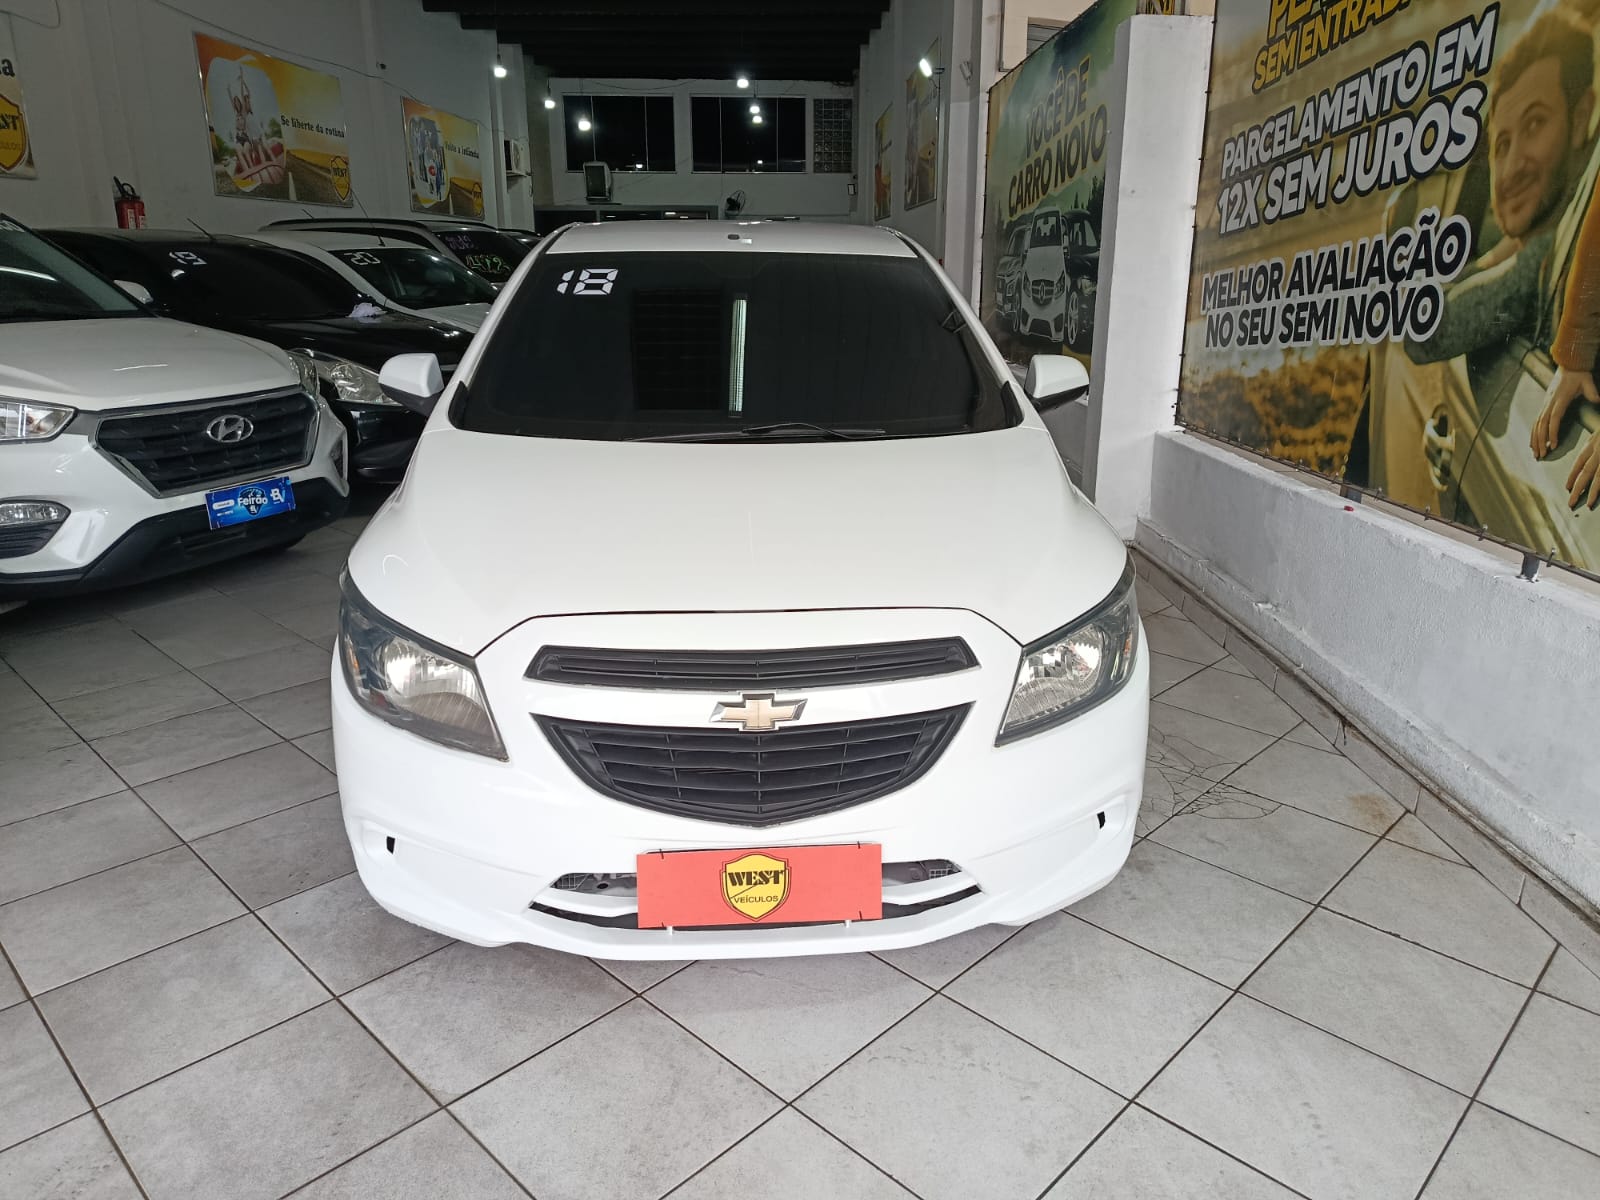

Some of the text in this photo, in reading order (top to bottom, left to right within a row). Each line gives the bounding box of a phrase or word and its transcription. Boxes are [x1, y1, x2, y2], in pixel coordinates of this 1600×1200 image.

[1253, 30, 1297, 91] SEM
[1026, 57, 1090, 157] VOCÊ DE
[1221, 10, 1497, 179] PARCELAMENTO EM
[1008, 104, 1108, 218] CARRO NOVO
[1217, 88, 1483, 235] 12X SEM JUROS
[556, 267, 619, 296] 18
[1202, 212, 1466, 311] MELHOR AVALIAÇÃO
[1205, 284, 1441, 348] NO SEU SEMI NOVO
[237, 492, 268, 506] Feirão
[728, 870, 783, 886] WEST
[733, 894, 779, 904] VEÍCULOS
